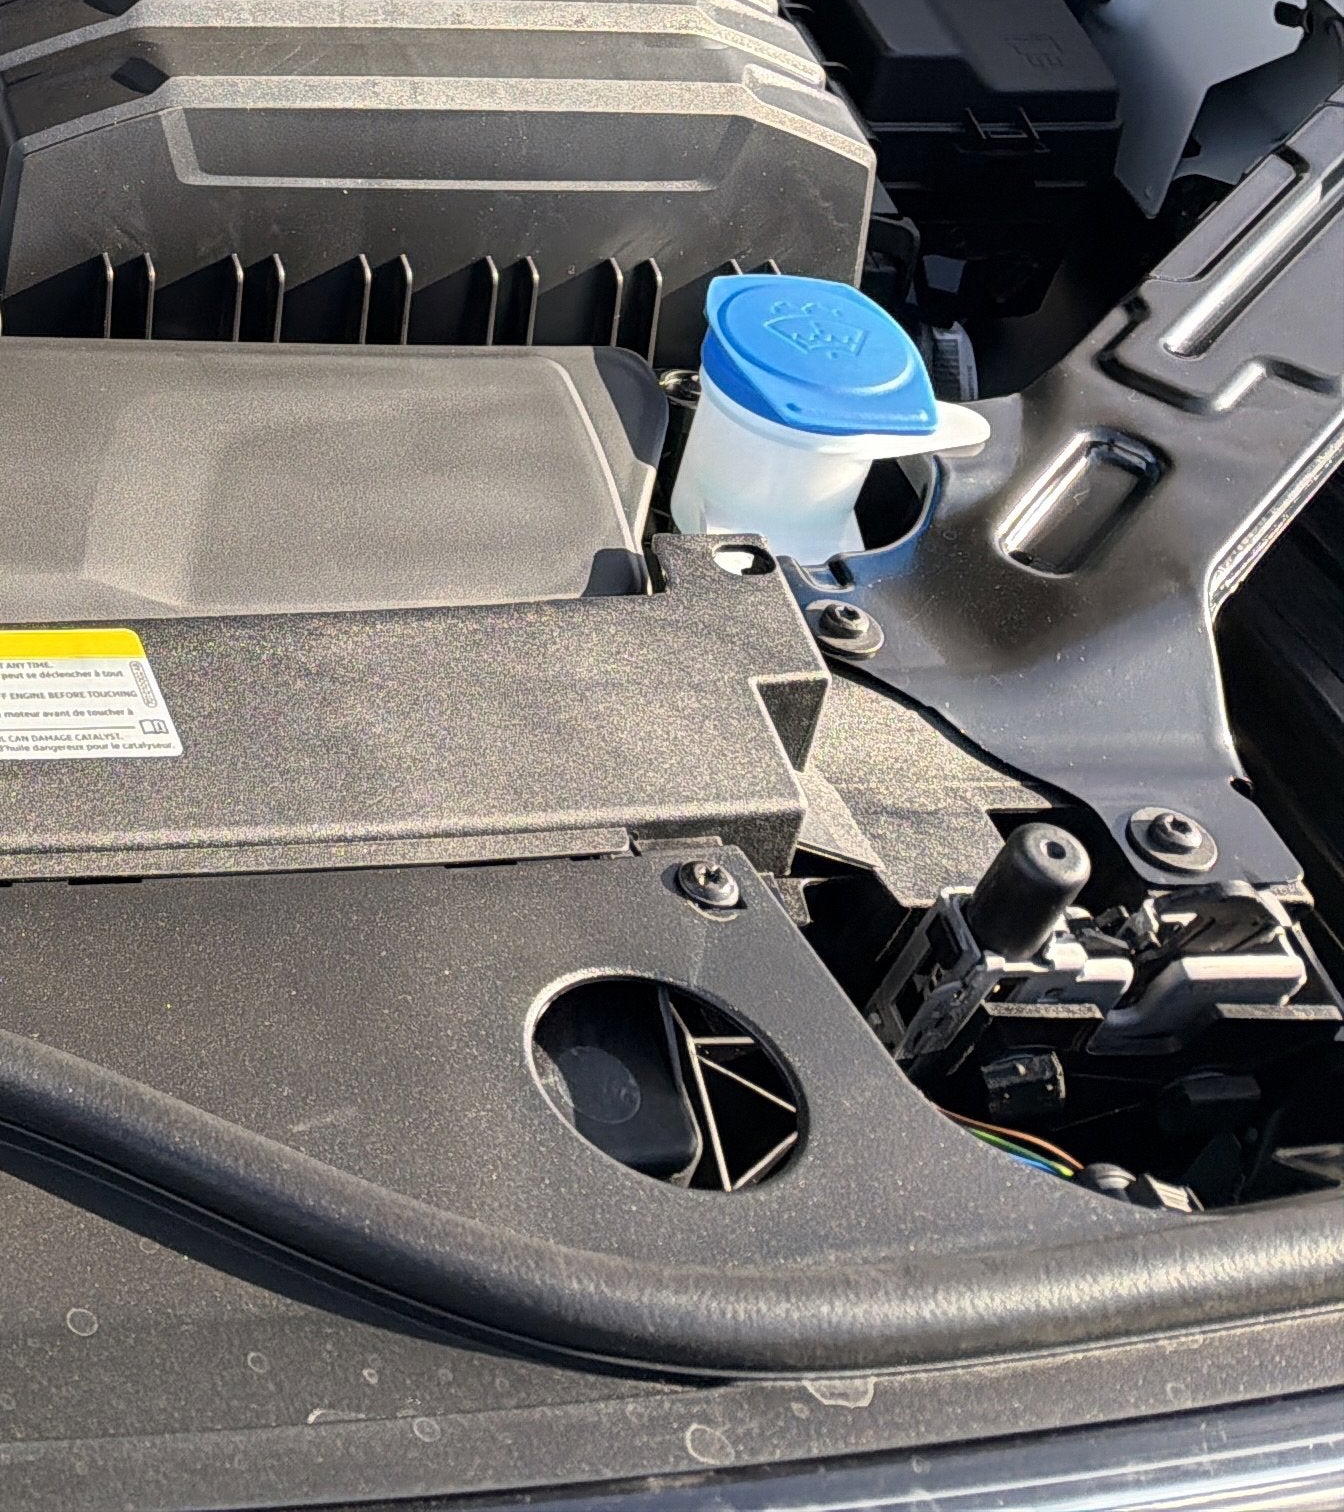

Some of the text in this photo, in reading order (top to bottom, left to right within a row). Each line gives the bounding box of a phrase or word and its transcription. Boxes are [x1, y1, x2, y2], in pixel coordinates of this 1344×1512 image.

[2, 672, 24, 680] peut
[10, 692, 46, 700] ENGINE
[48, 691, 85, 699] BEFORE
[74, 733, 124, 741] CATALYST.
[33, 745, 84, 753] dangereux
[86, 743, 109, 751] pour
[122, 742, 175, 750] catalyseur.
